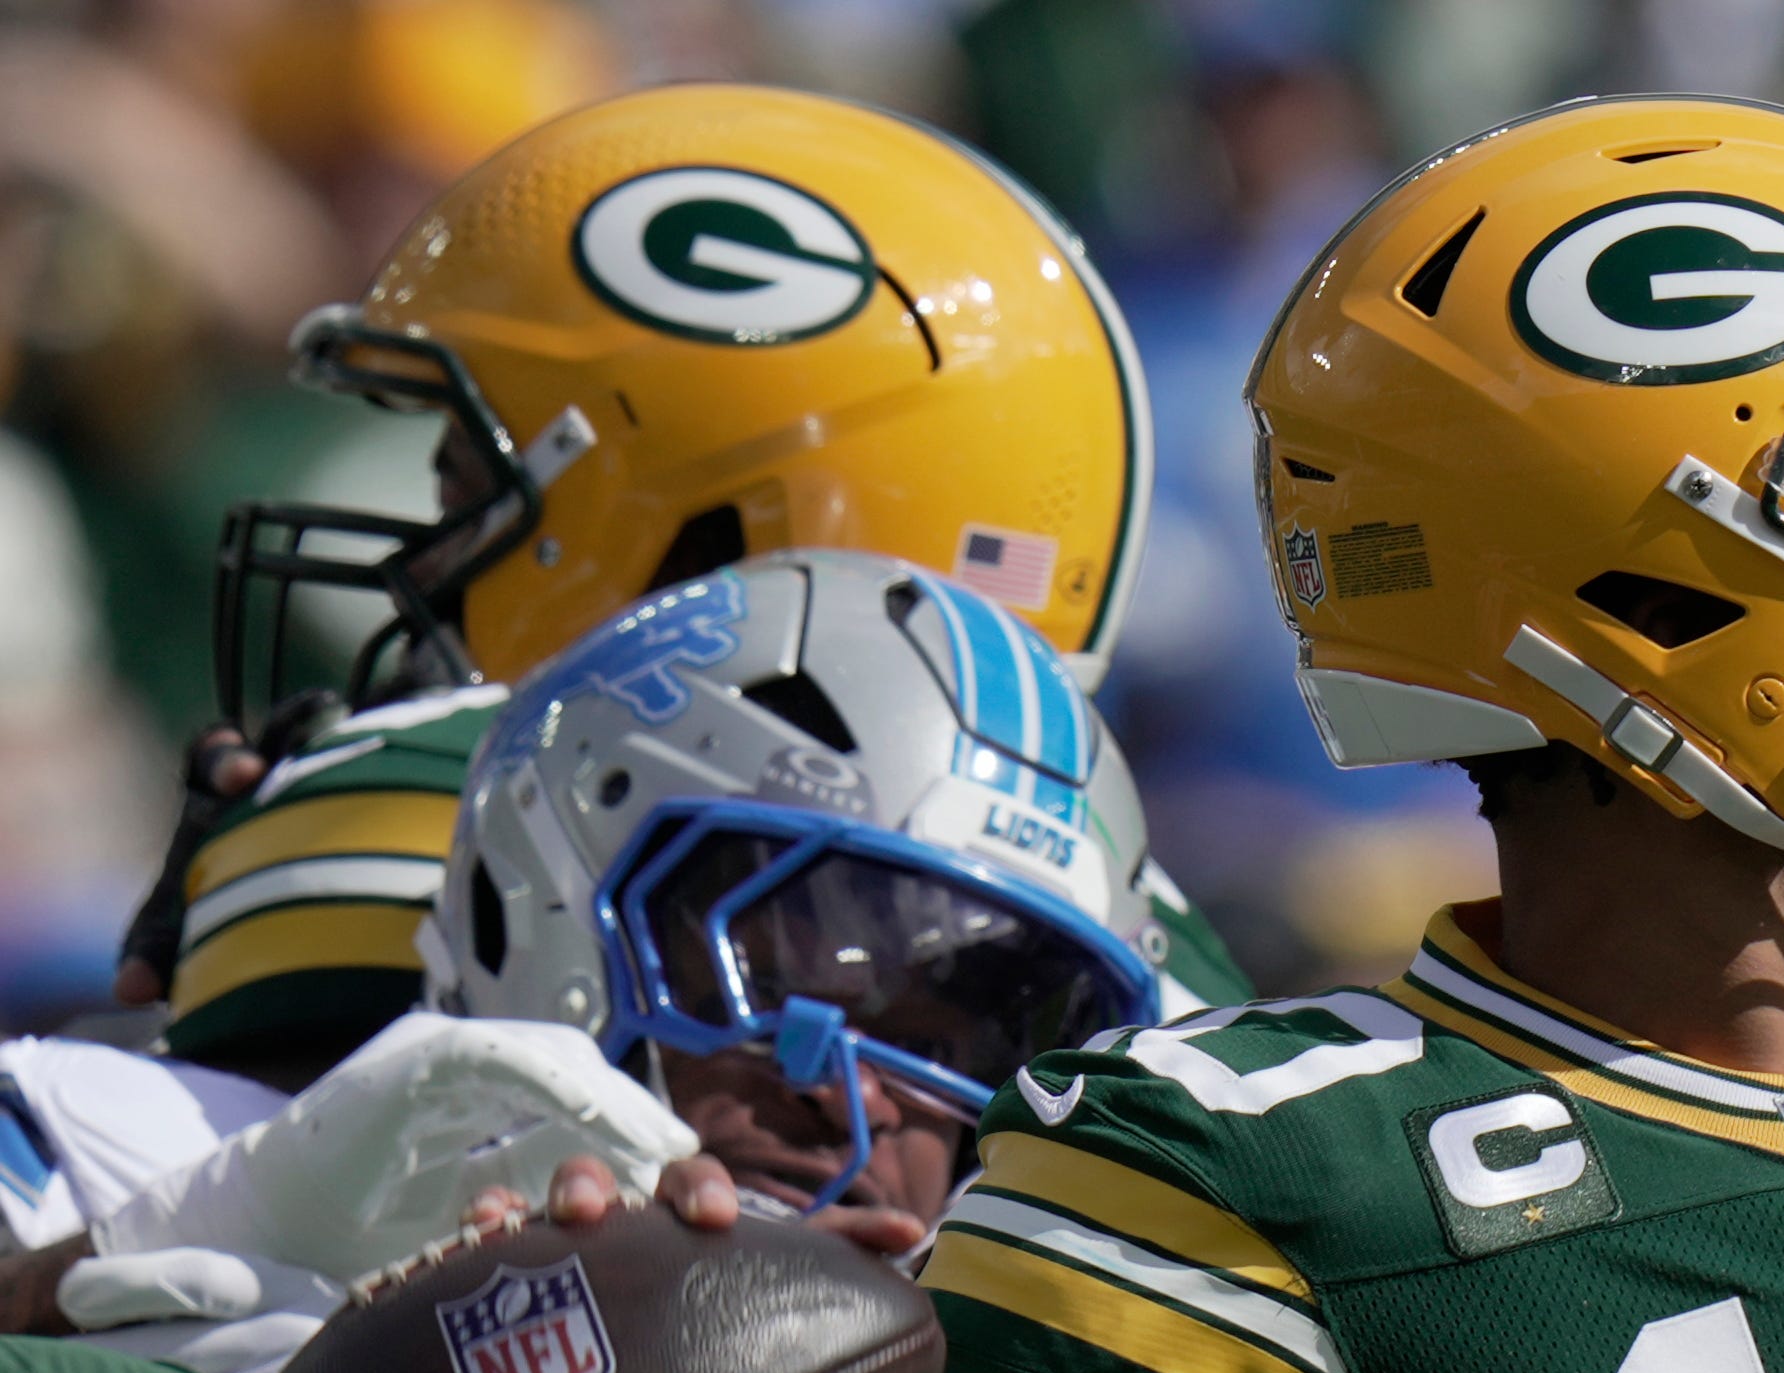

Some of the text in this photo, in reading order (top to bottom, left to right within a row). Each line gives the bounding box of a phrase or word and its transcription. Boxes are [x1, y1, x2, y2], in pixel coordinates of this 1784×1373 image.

[581, 168, 864, 338] G
[1292, 562, 1321, 597] NFL
[1429, 1093, 1587, 1208] C
